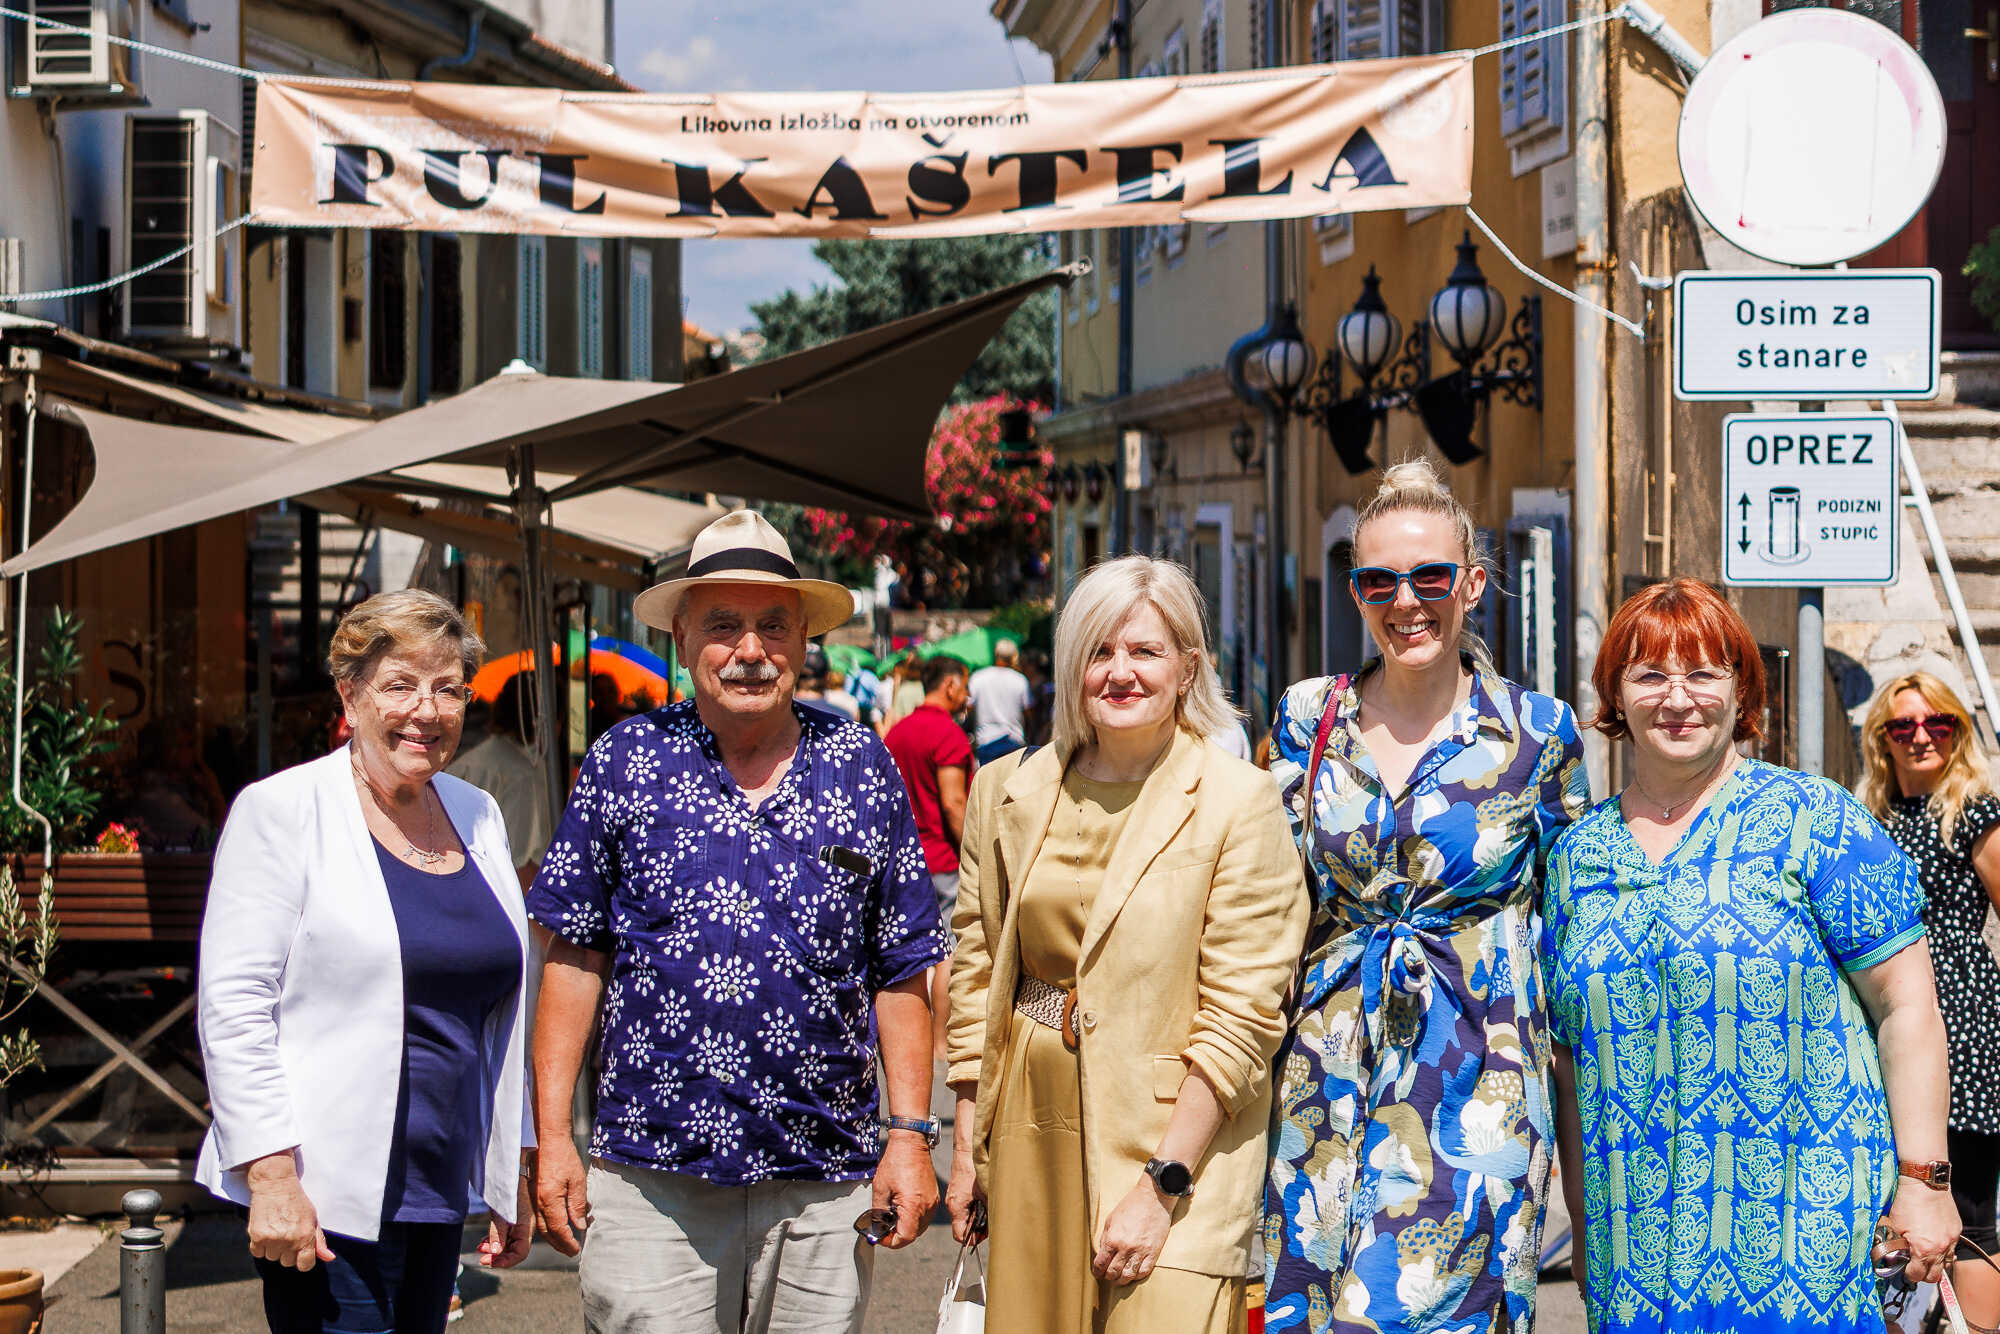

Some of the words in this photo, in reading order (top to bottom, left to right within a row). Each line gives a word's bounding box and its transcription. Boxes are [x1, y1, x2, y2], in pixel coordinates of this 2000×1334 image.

[680, 114, 772, 134] Likovna
[780, 112, 861, 132] izložba
[869, 116, 898, 131] na
[905, 112, 1031, 130] otvorenom
[317, 143, 608, 215] PUL
[660, 126, 1409, 220] KAŠTELA
[1736, 299, 1817, 327] Osim
[1832, 304, 1871, 326] za
[1737, 343, 1869, 369] stanare
[1746, 434, 1874, 466] OPREZ
[1817, 499, 1882, 514] PODIZNI
[1820, 524, 1879, 541] STUPIĆ
